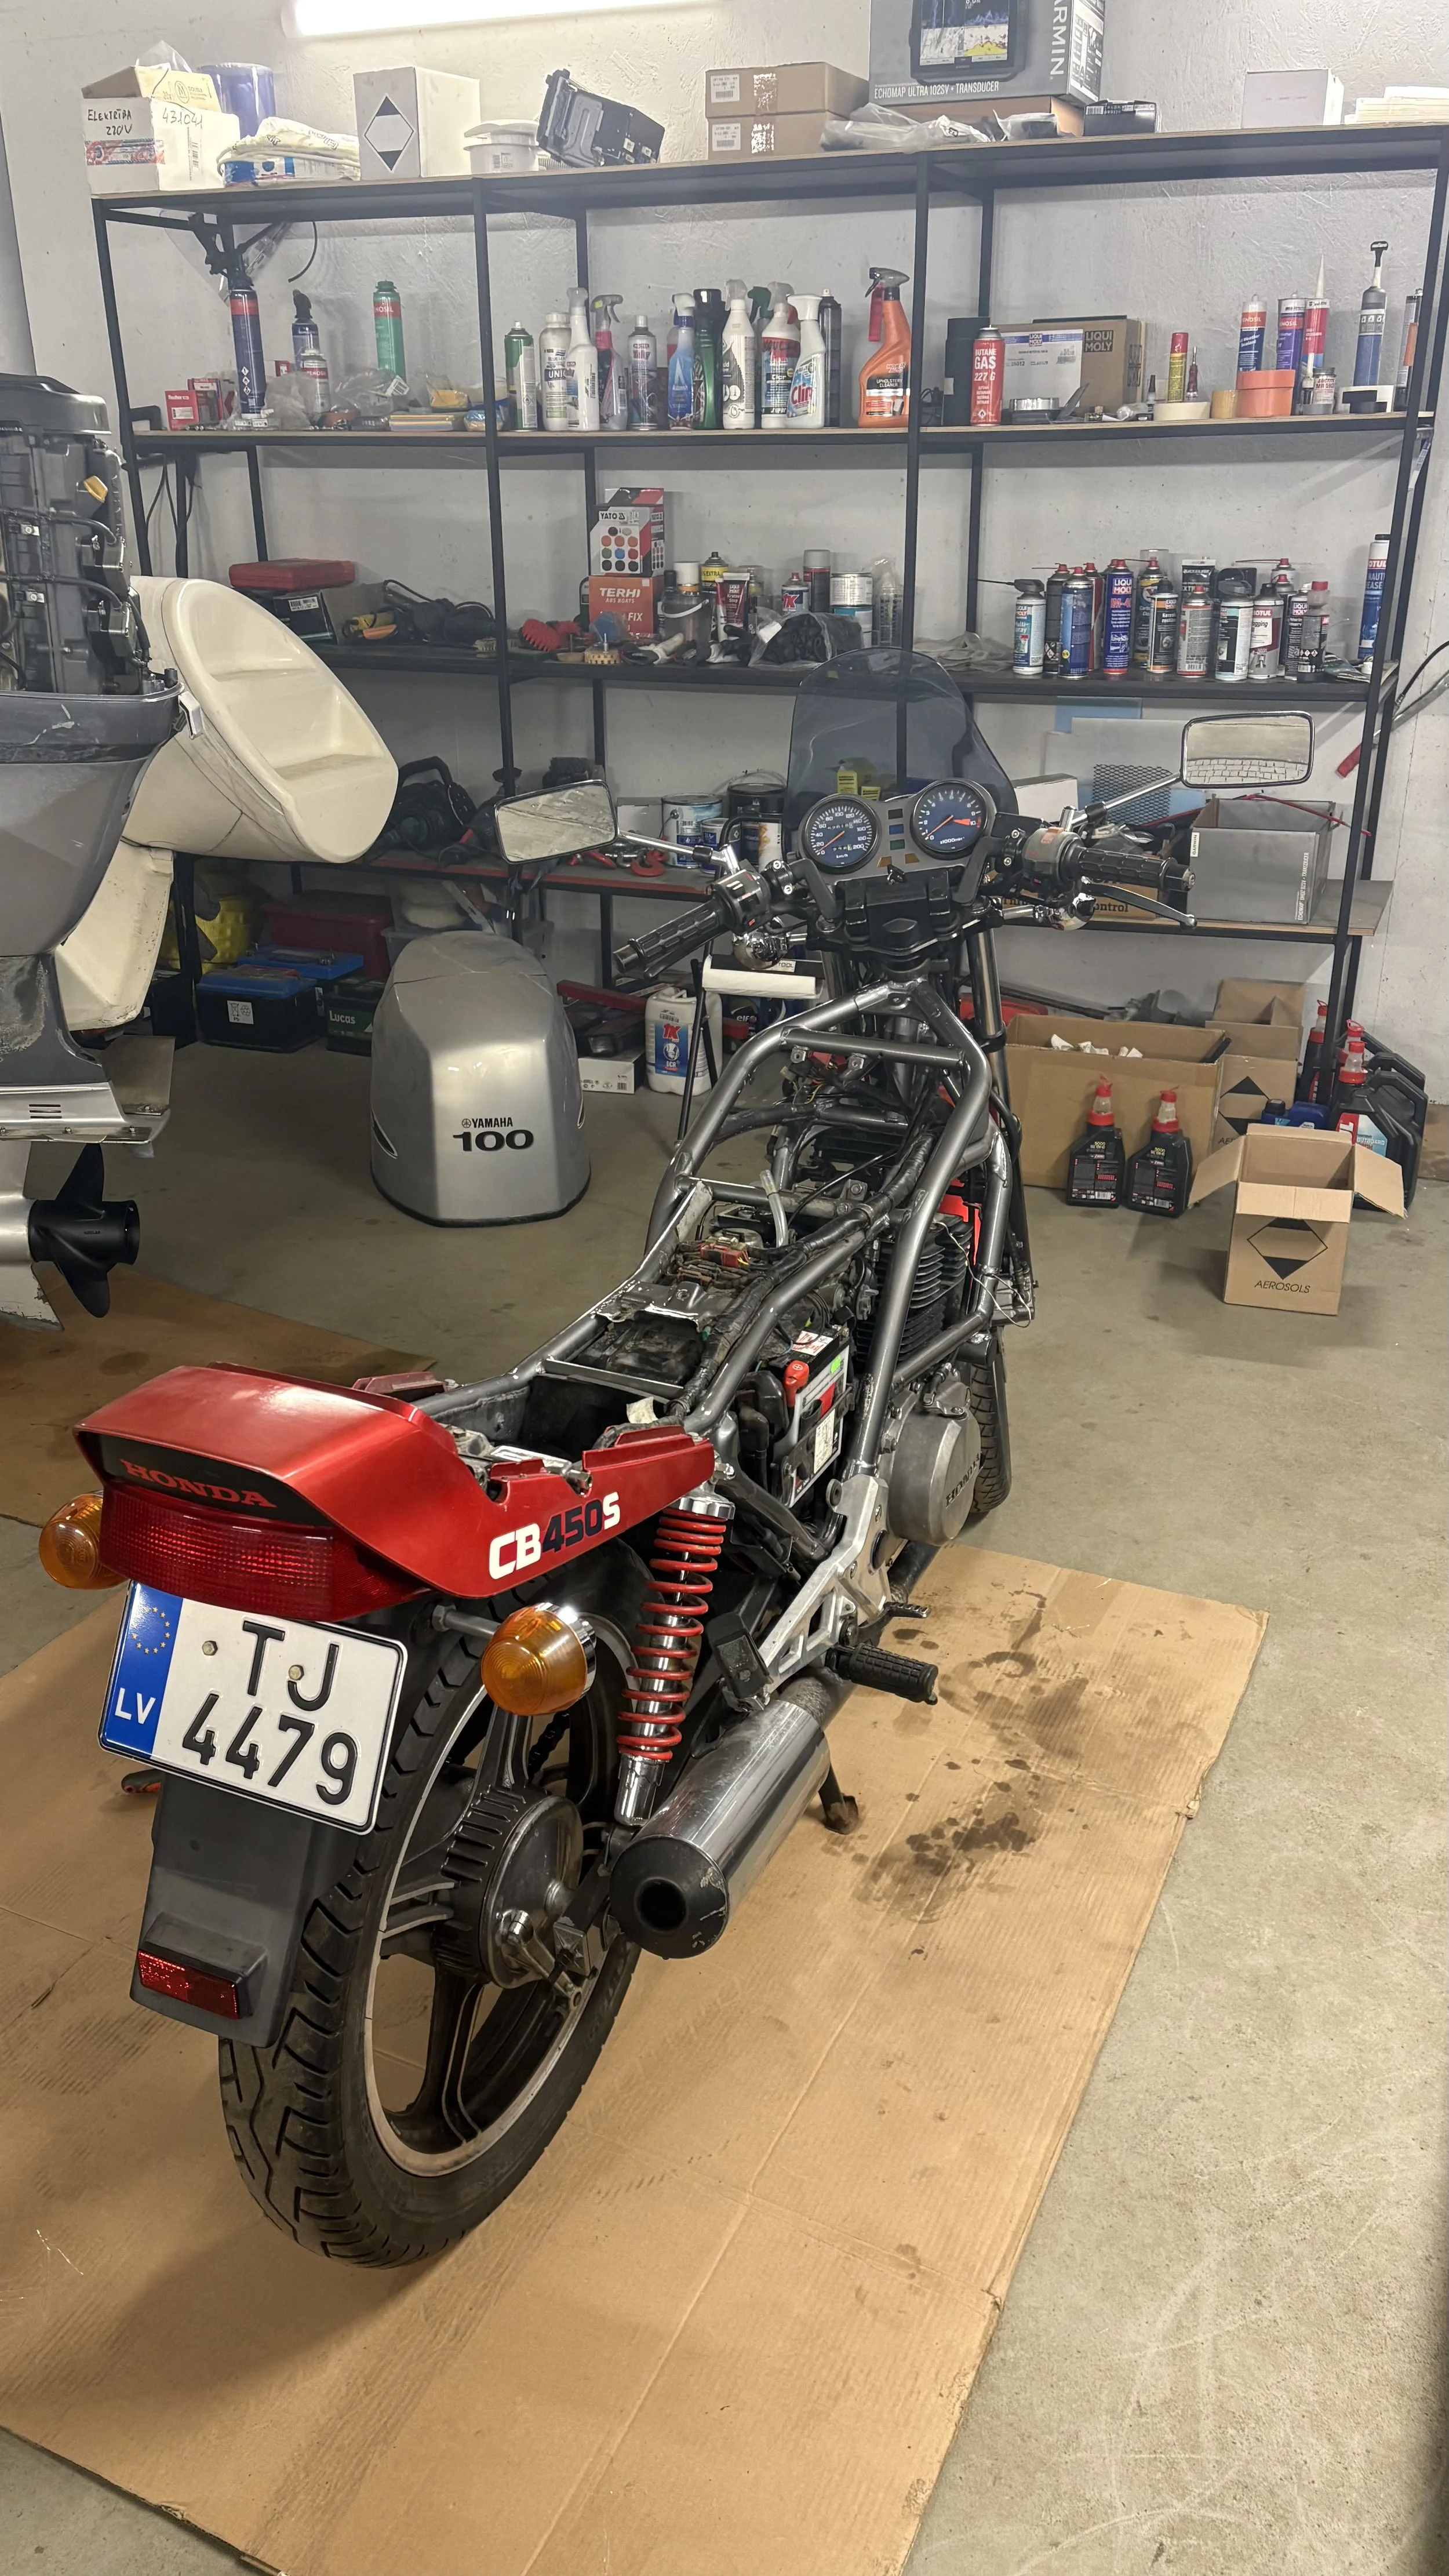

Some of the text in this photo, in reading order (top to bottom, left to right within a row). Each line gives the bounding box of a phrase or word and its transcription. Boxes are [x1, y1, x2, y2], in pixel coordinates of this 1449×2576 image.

[875, 81, 999, 99] ECHOMAP ULTRA 102SV TRANSDUCER
[105, 123, 133, 136] 220V
[1086, 332, 1112, 341] LIQUI
[1085, 342, 1112, 352] MOLY
[975, 356, 996, 370] GAS
[974, 372, 988, 381] 227
[1367, 581, 1383, 590] EASE
[600, 588, 640, 598] TERHI
[628, 612, 643, 621] FIX
[1095, 901, 1129, 912] ontrol
[329, 1010, 356, 1025] Lucas
[472, 1117, 513, 1128] YAMAHA
[453, 1129, 534, 1152] 100
[1254, 1280, 1310, 1293] AEROSOLS
[120, 1458, 277, 1508] HONDA
[489, 1491, 621, 1580] CB450S
[242, 1620, 340, 1712] TJ
[114, 1687, 156, 1725] LV
[181, 1693, 359, 1806] 4479
